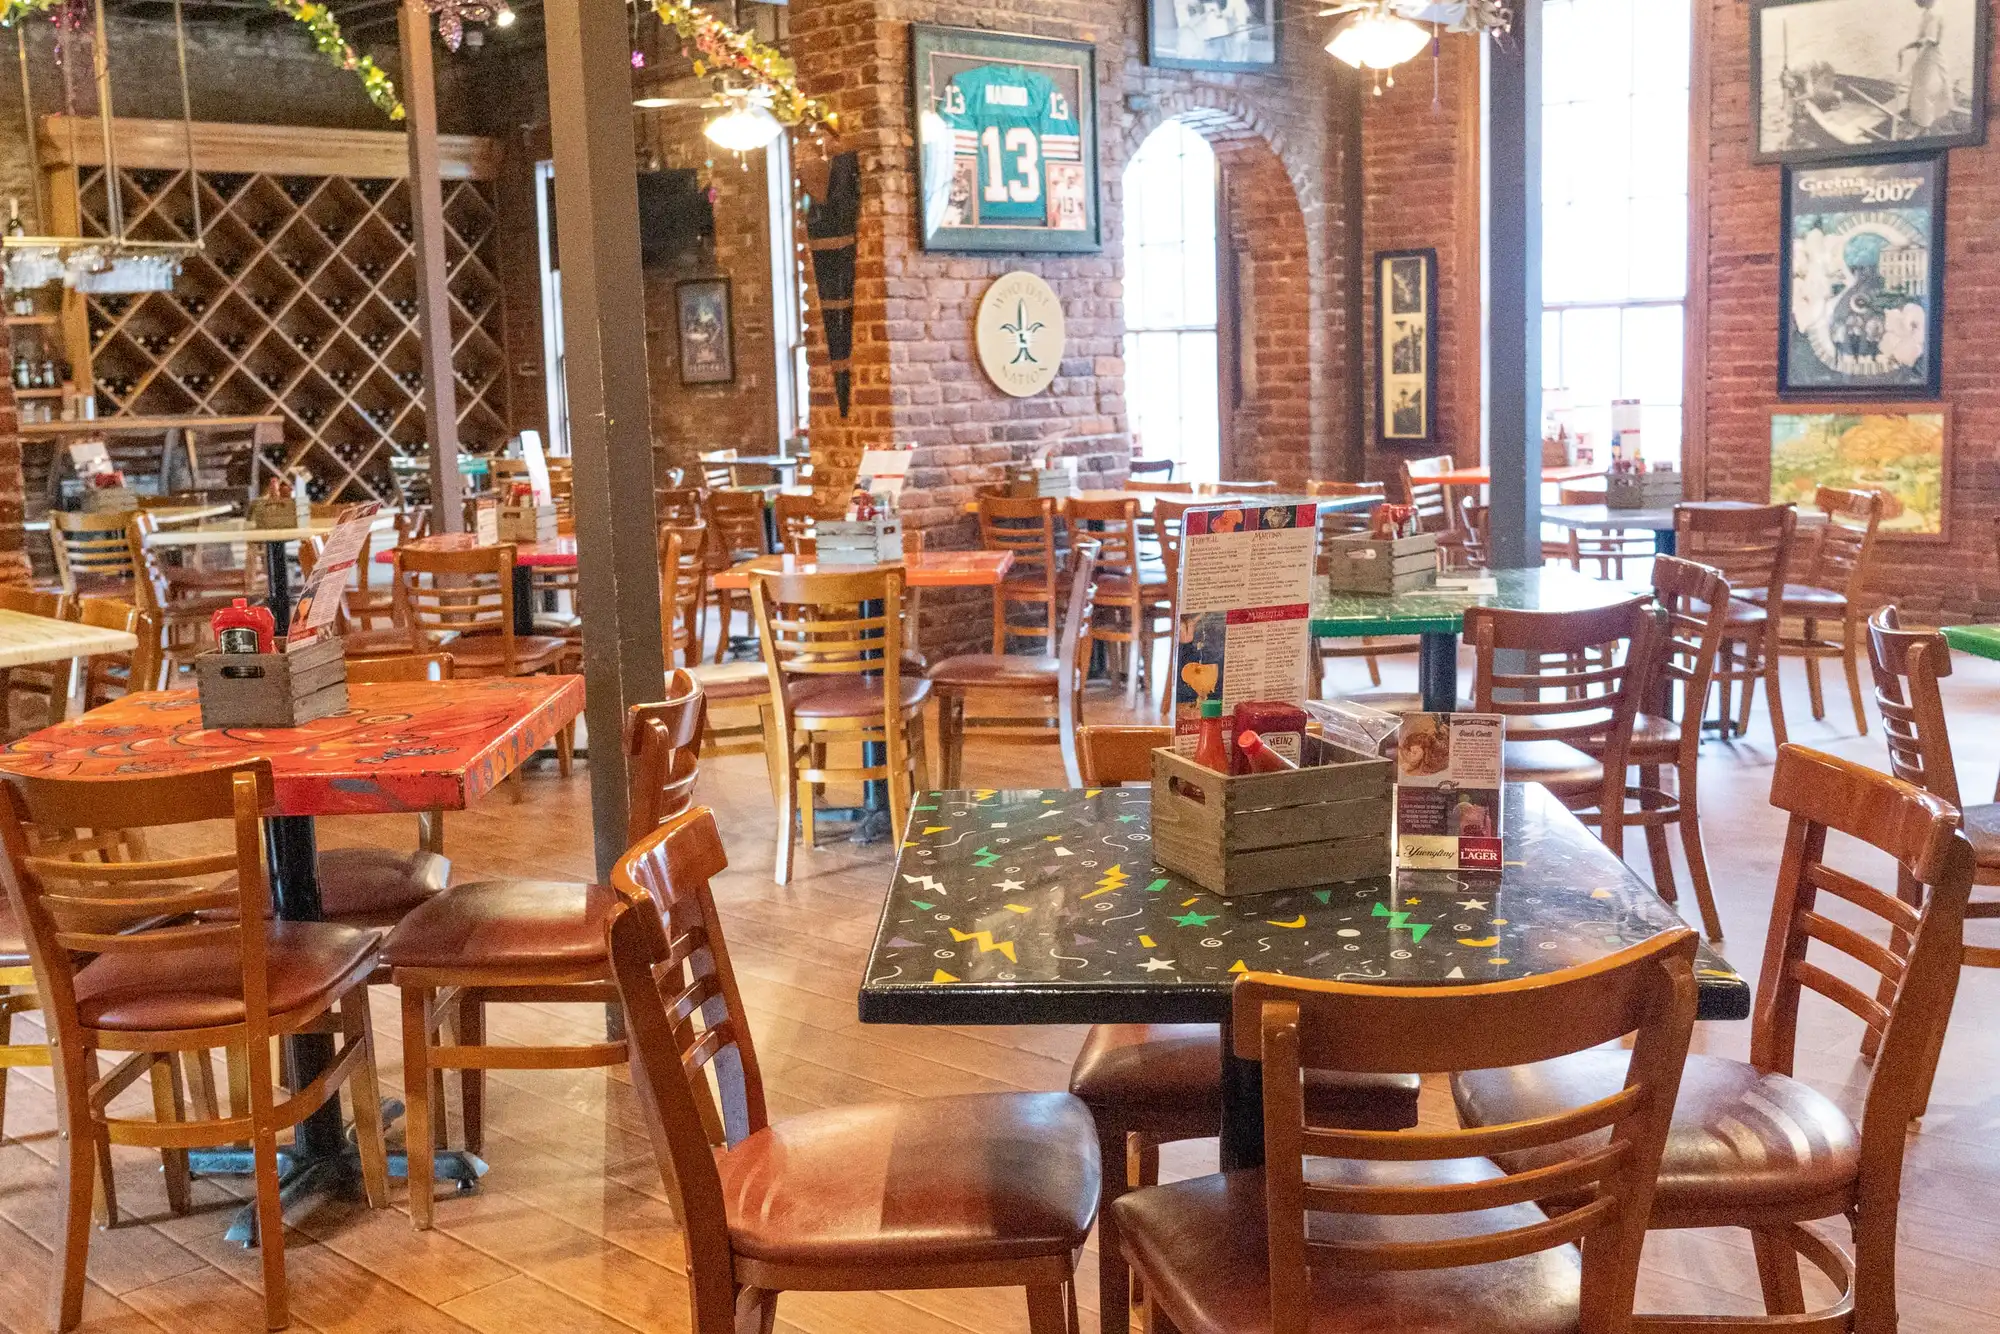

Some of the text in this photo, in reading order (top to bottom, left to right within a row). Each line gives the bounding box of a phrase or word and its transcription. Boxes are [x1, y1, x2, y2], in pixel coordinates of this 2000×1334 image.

[944, 85, 966, 114] 13
[1049, 92, 1069, 120] 13
[982, 126, 1041, 203] 13
[1798, 176, 1865, 192] Gretna
[1861, 184, 1918, 203] 2007
[1269, 736, 1293, 746] HEINZ
[1404, 845, 1456, 859] Yuengling
[1460, 851, 1498, 861] LAGER
